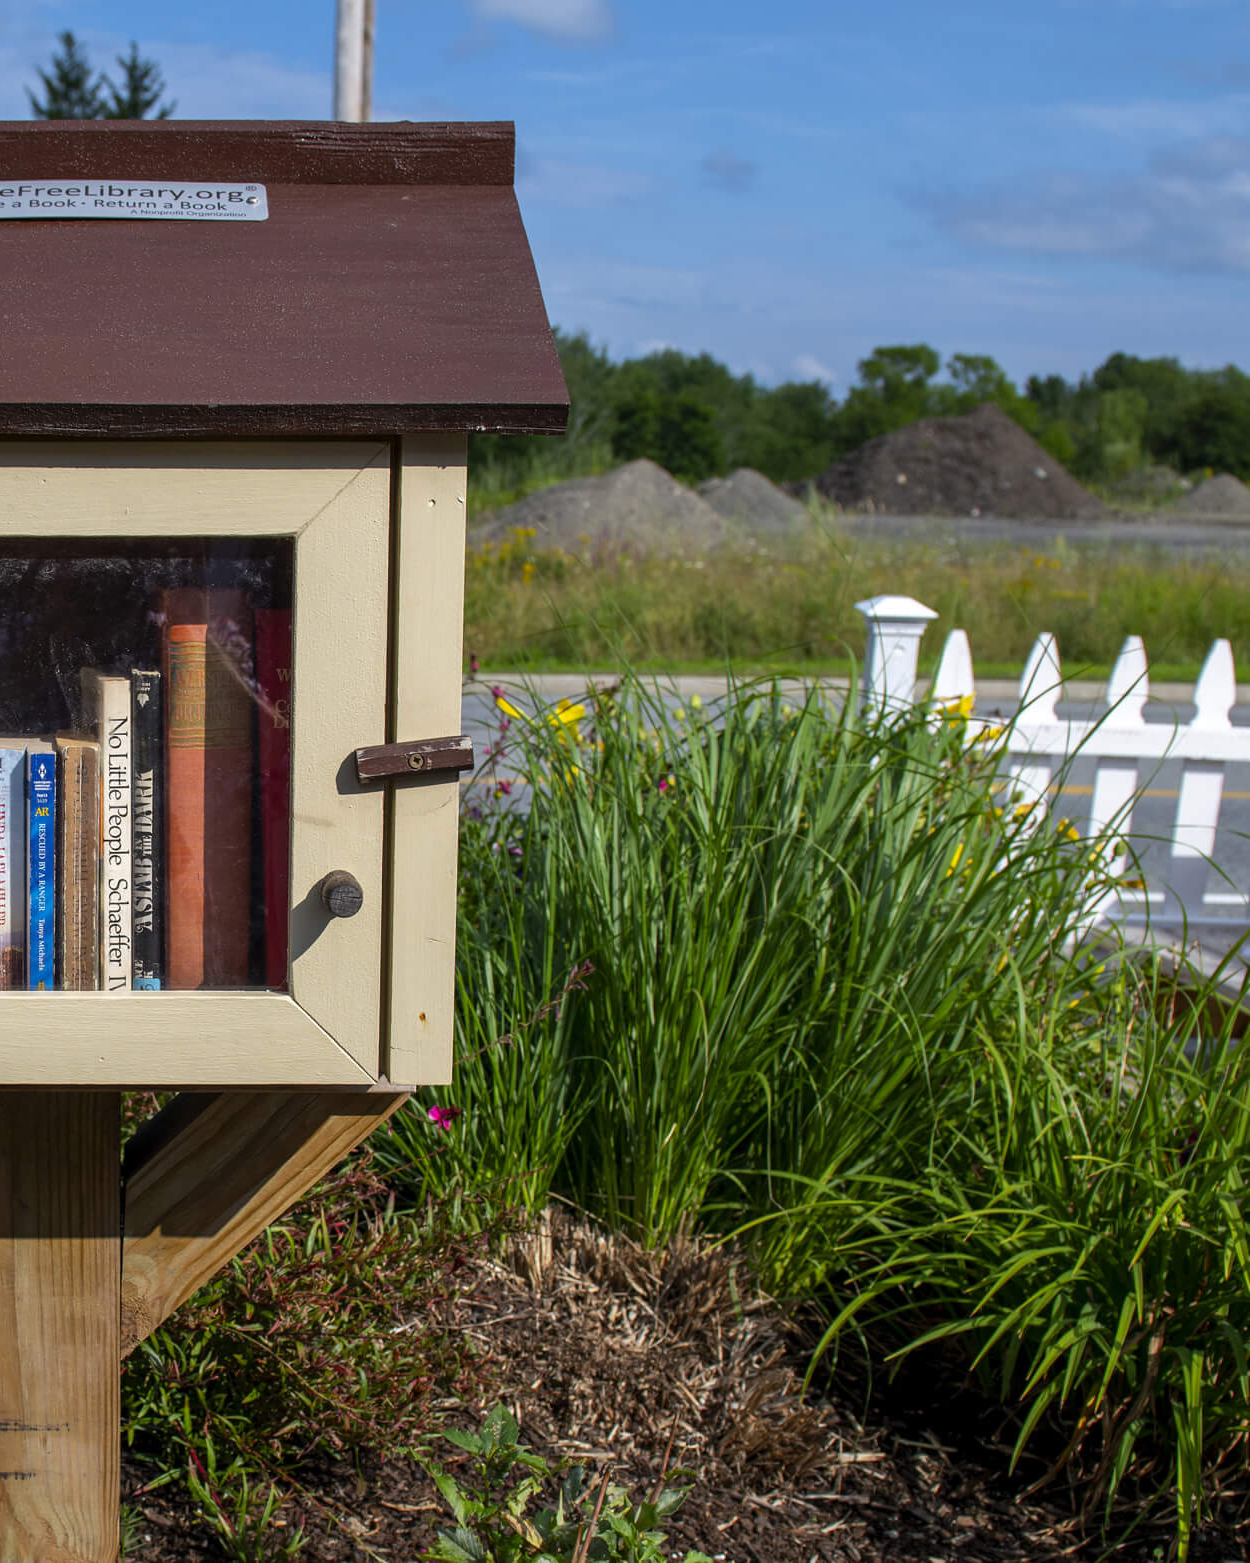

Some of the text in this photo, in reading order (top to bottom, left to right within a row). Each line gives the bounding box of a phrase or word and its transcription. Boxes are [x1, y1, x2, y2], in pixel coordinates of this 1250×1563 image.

[29, 199, 76, 208] Book
[94, 199, 157, 209] Return
[180, 201, 227, 211] Book
[140, 209, 184, 217] Nonprofit
[186, 210, 247, 218] Organization
[109, 716, 129, 749] No
[108, 752, 130, 800] Little
[34, 807, 50, 817] AR
[134, 769, 154, 834] DARK
[38, 823, 46, 860] RESCUED
[103, 804, 130, 866] People
[141, 835, 153, 857] THE
[38, 861, 46, 871] BY
[38, 880, 46, 911] RANGER
[134, 857, 153, 913] STAB
[108, 878, 130, 967] Schaeffer
[135, 913, 153, 934] A
[37, 918, 46, 971] Tanya Michaels
